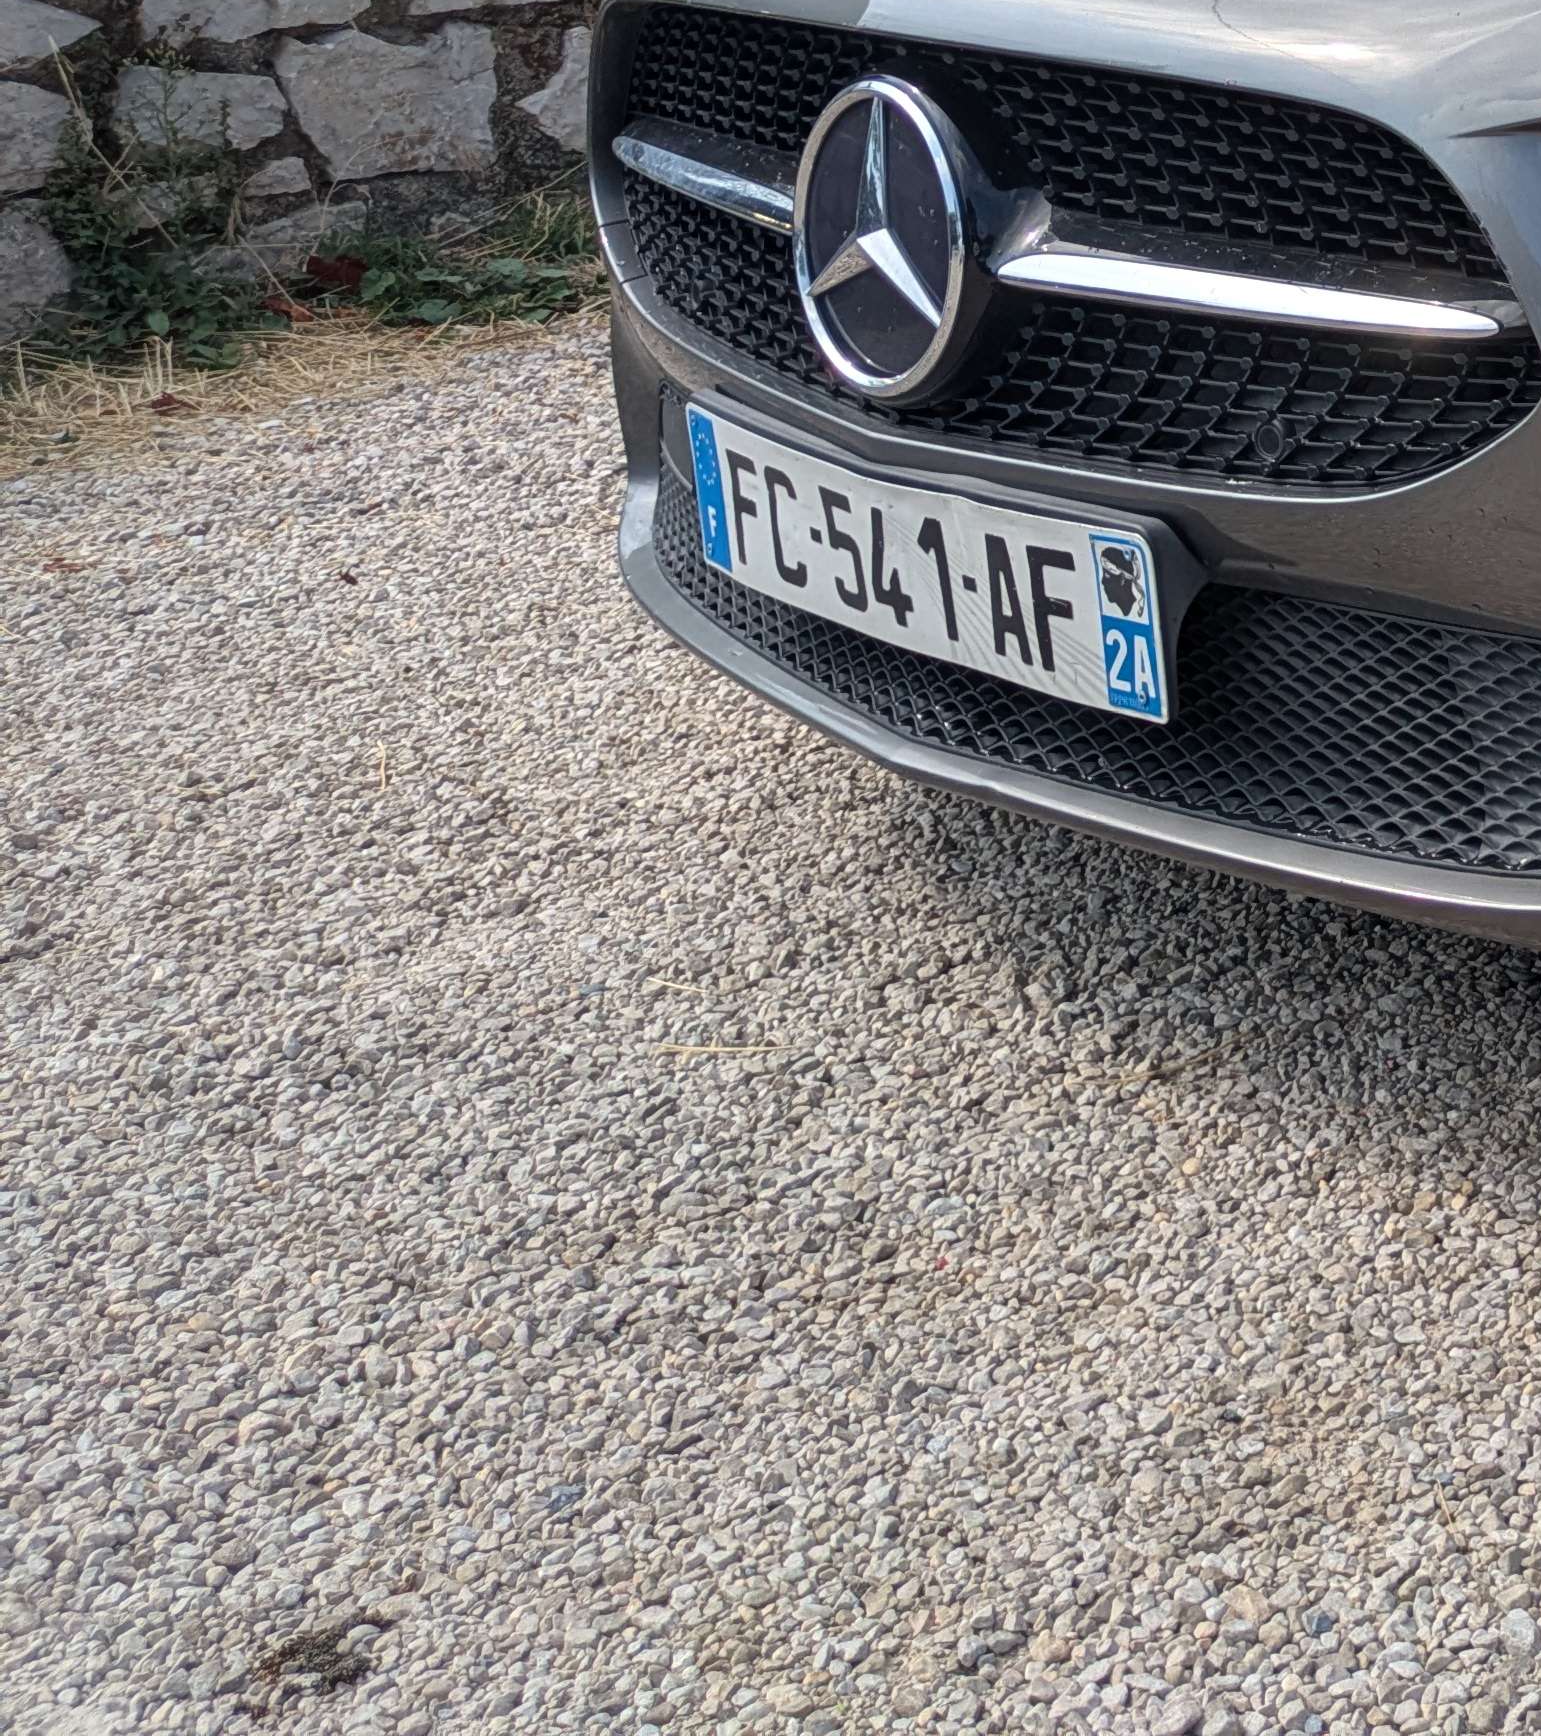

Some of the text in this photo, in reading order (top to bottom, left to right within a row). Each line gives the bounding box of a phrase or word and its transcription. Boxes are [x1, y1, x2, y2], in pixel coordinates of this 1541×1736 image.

[707, 505, 717, 537] F
[726, 448, 1076, 671] FC-541-AF
[1106, 629, 1157, 698] 2A
